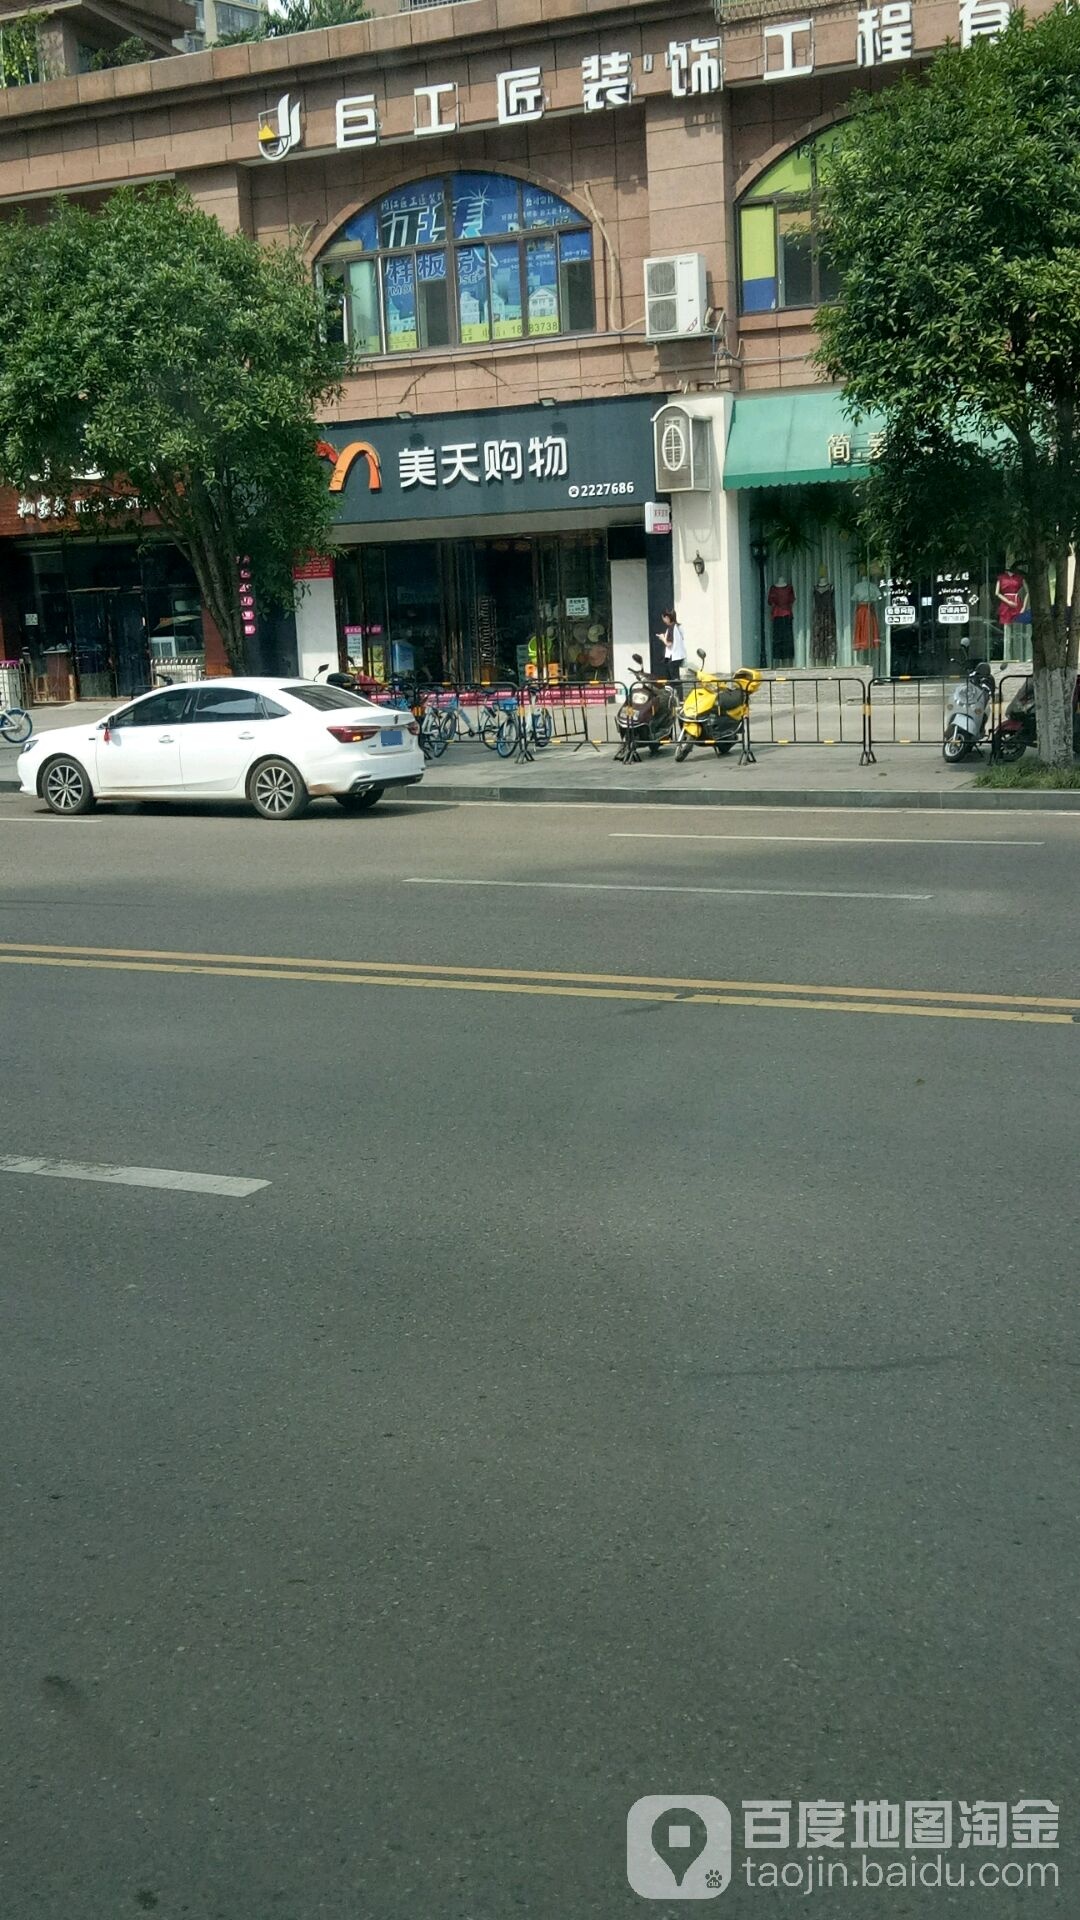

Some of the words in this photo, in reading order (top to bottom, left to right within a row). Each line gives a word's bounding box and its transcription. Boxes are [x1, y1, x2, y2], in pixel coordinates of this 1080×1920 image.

[335, 0, 1074, 150] 巨工匠装饰工程有
[511, 321, 558, 334] 1883738
[398, 434, 568, 488] 美天购物
[580, 481, 635, 497] 2227686
